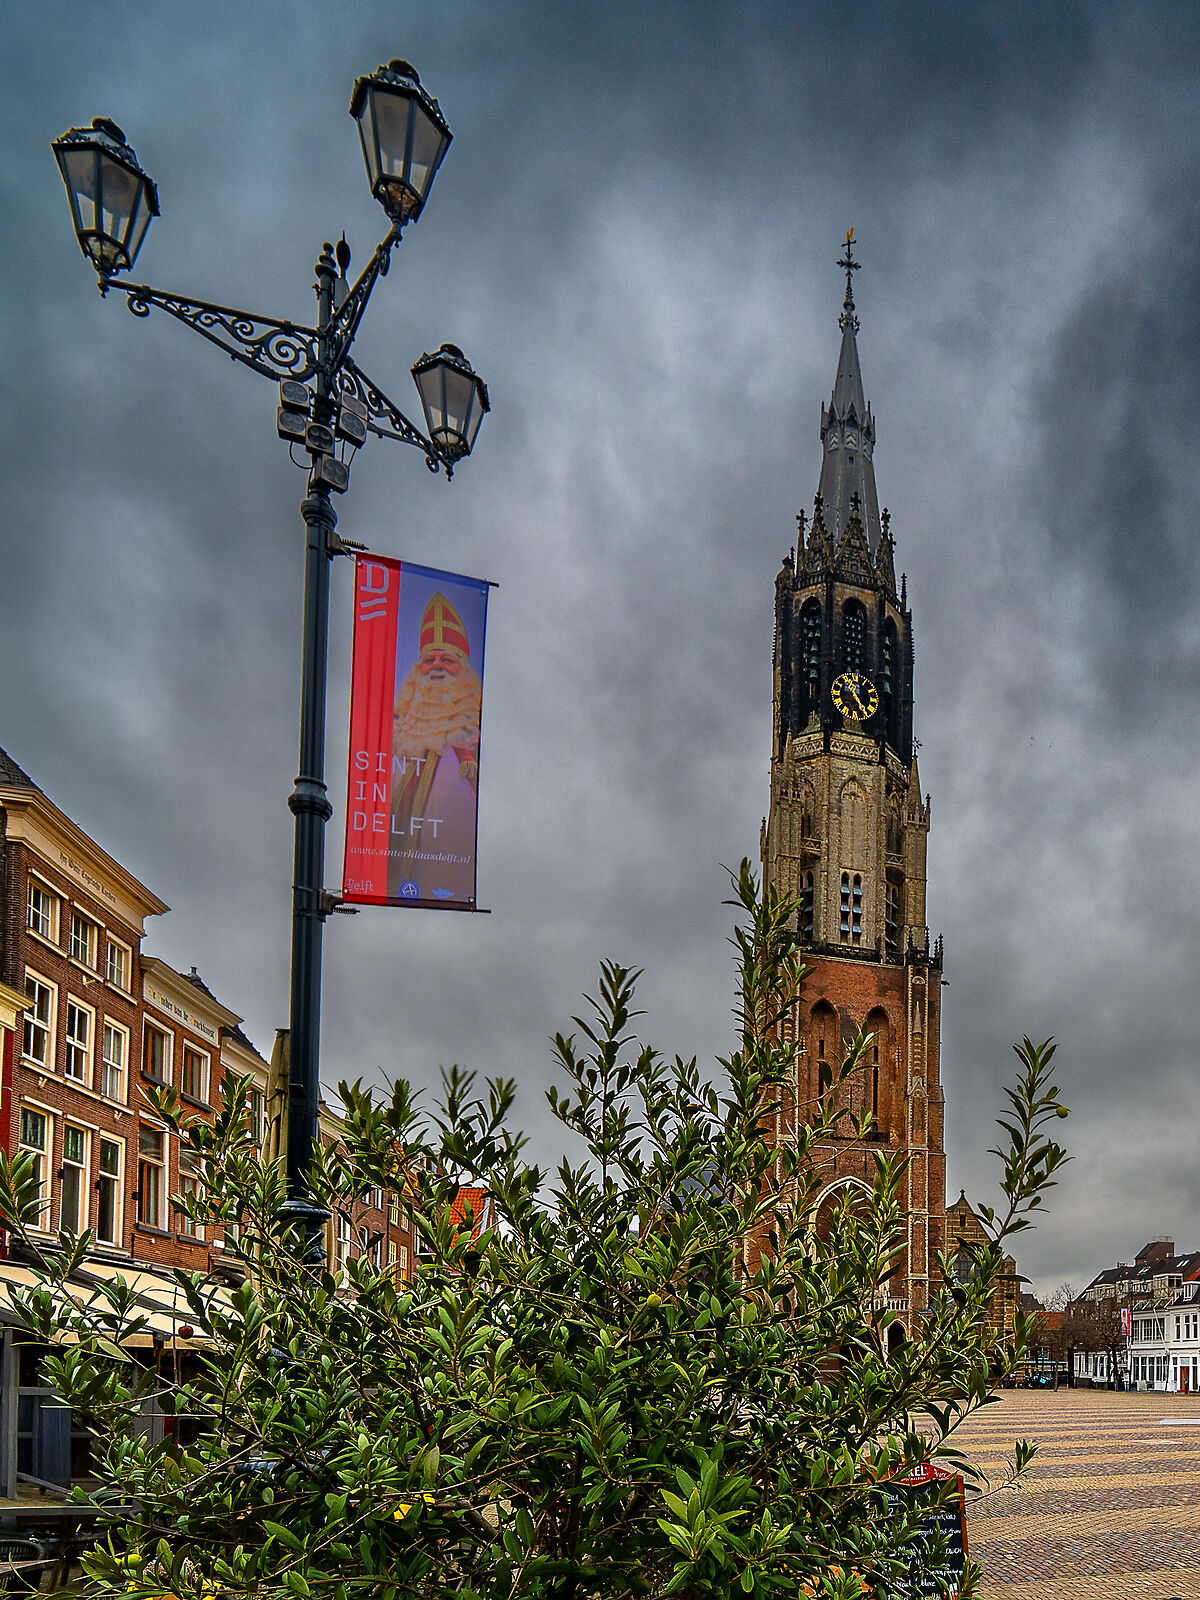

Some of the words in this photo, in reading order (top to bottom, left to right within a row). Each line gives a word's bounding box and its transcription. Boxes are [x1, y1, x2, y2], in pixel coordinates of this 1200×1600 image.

[354, 750, 427, 777] SINT
[355, 780, 387, 803] IN
[353, 811, 444, 839] DELFT
[350, 846, 472, 865] www.sinterklaasdelft.nl
[347, 878, 374, 894] Delft
